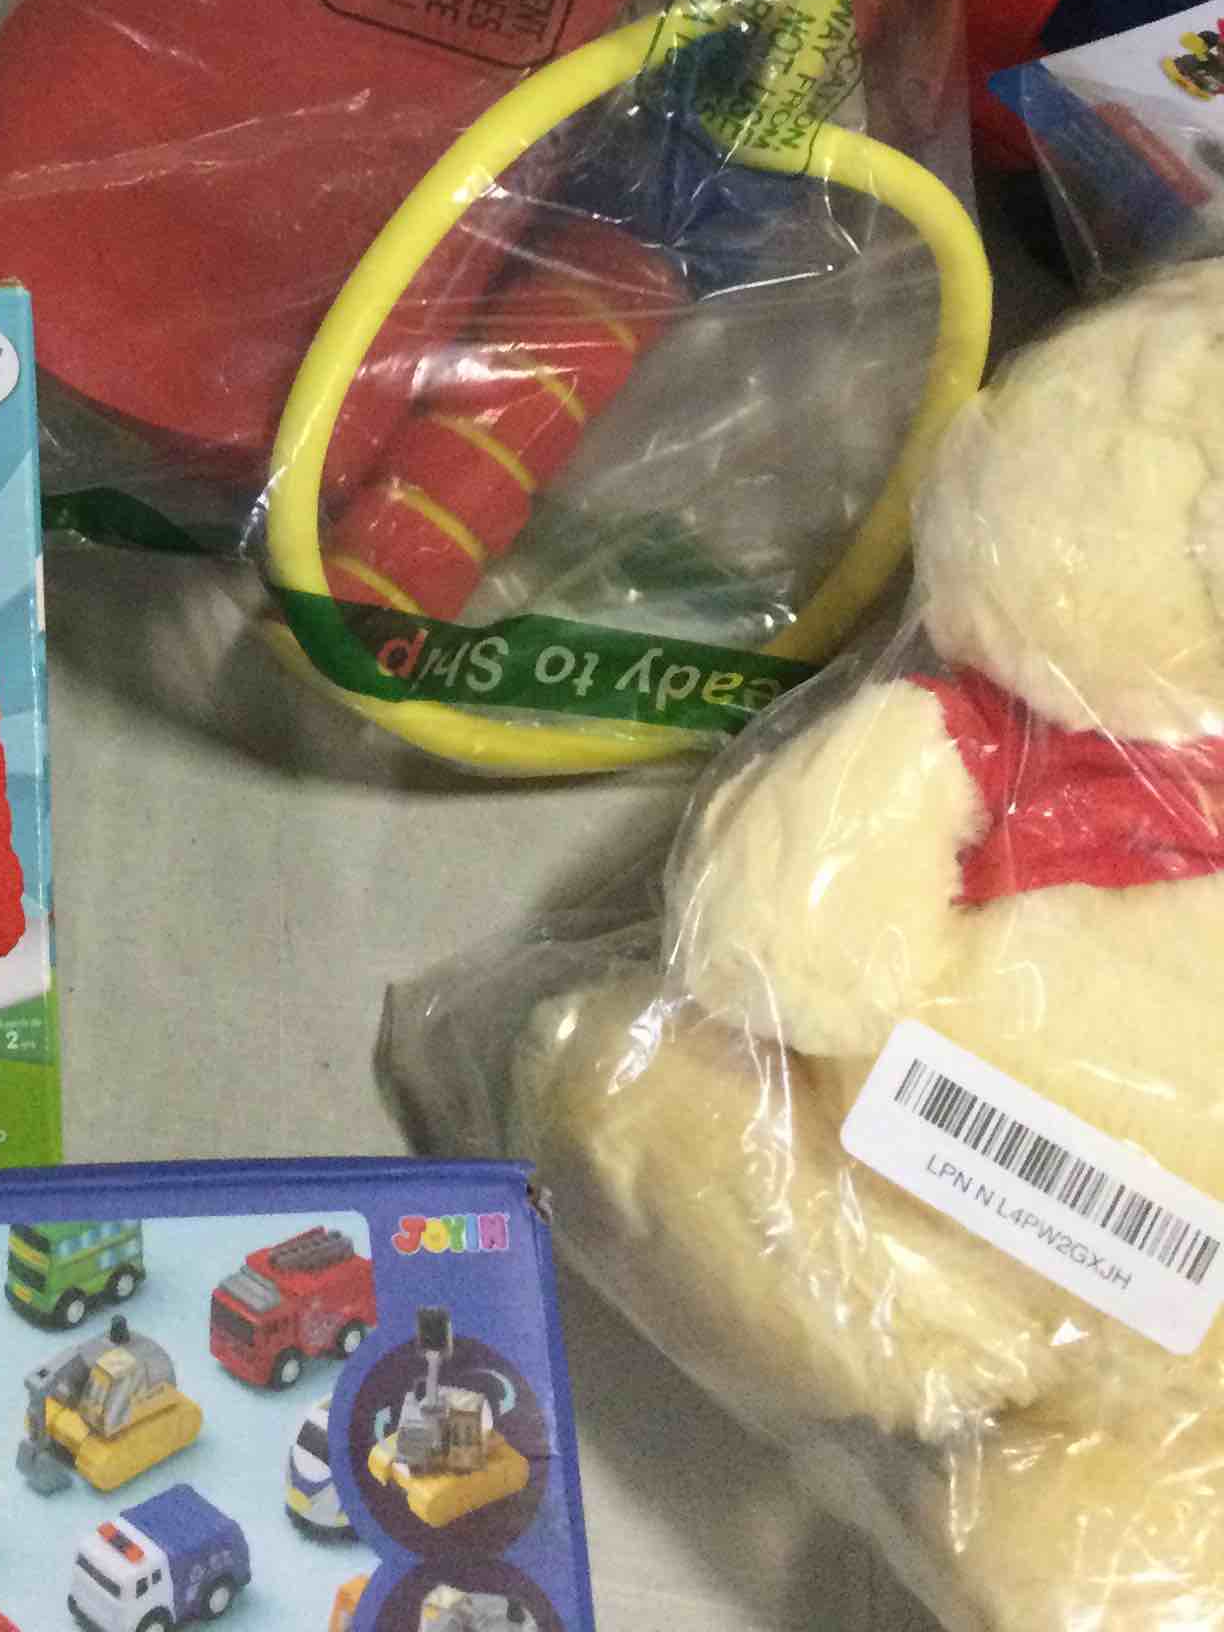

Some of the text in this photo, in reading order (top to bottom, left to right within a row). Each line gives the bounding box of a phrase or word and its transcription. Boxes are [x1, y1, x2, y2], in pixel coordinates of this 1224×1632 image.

[761, 9, 814, 72] NOT
[376, 625, 778, 712] eady to Ship
[925, 1153, 975, 1194] LPN
[392, 1213, 510, 1256] JOYIN
